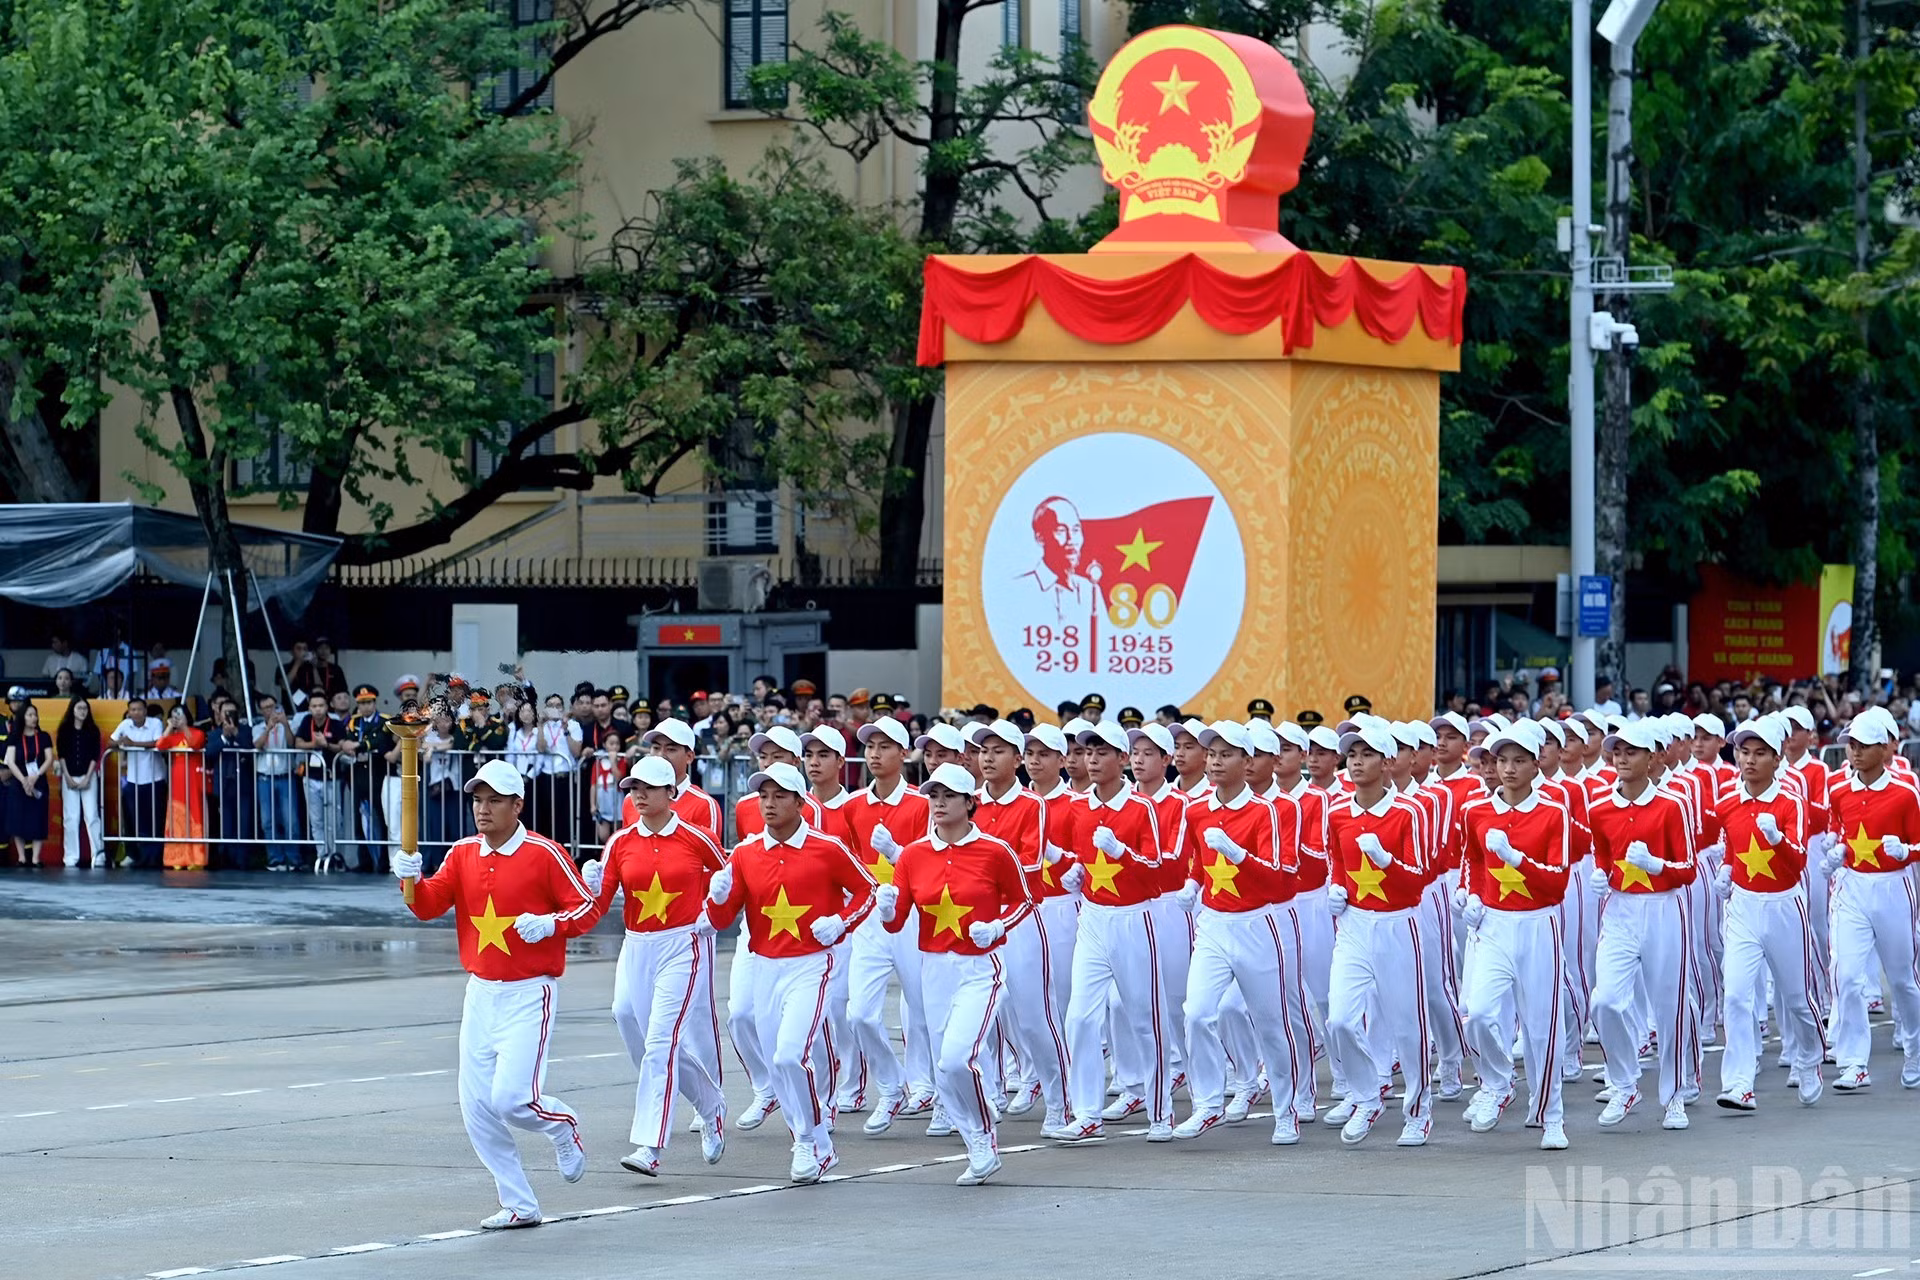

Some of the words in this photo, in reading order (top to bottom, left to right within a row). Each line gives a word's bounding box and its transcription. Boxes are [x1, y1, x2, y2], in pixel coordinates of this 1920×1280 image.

[1108, 582, 1178, 629] 80
[1022, 625, 1079, 648] 19-8
[1108, 635, 1174, 653] 1945
[1035, 650, 1079, 673] 2-9
[1108, 656, 1174, 675] 2025
